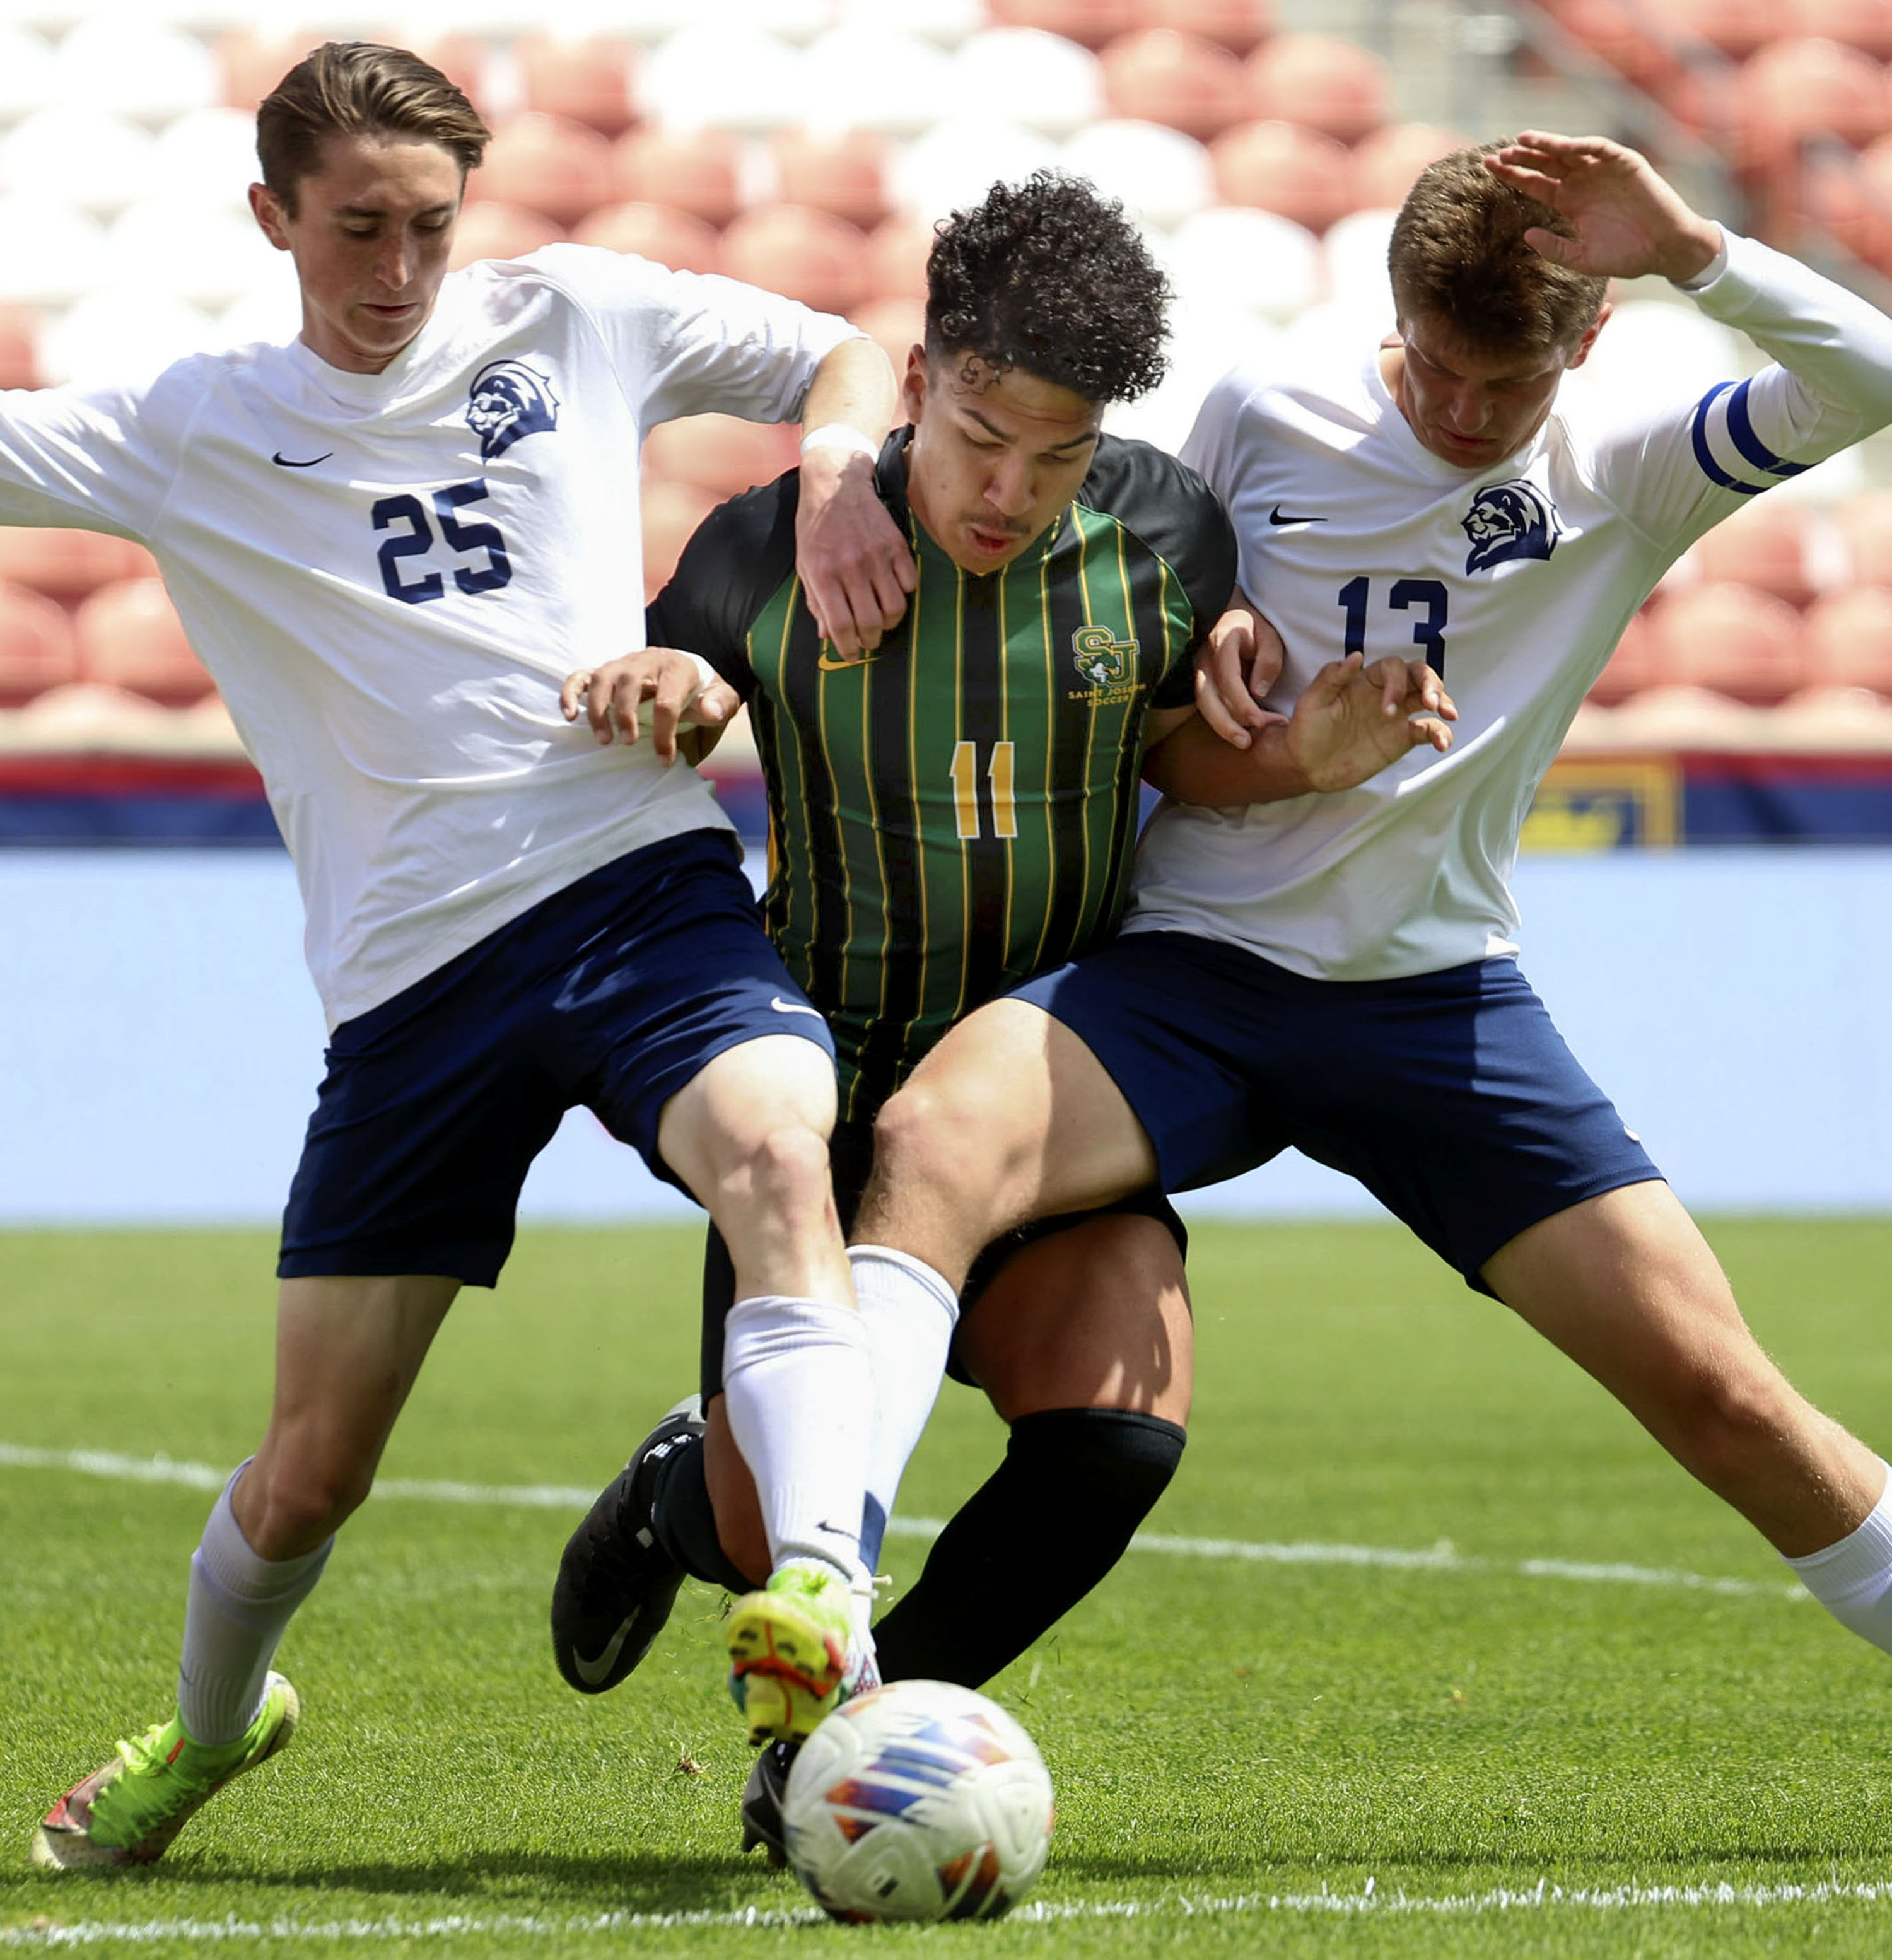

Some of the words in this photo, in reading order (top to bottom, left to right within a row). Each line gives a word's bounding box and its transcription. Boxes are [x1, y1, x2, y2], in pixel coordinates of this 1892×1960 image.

[371, 477, 512, 605] 25
[1072, 625, 1140, 686] SJ
[1338, 576, 1448, 681] 13
[1068, 689, 1104, 700] SAINT
[1107, 683, 1147, 696] JOSEPH
[1087, 695, 1129, 706] SOCCER
[949, 740, 1018, 839] 11
